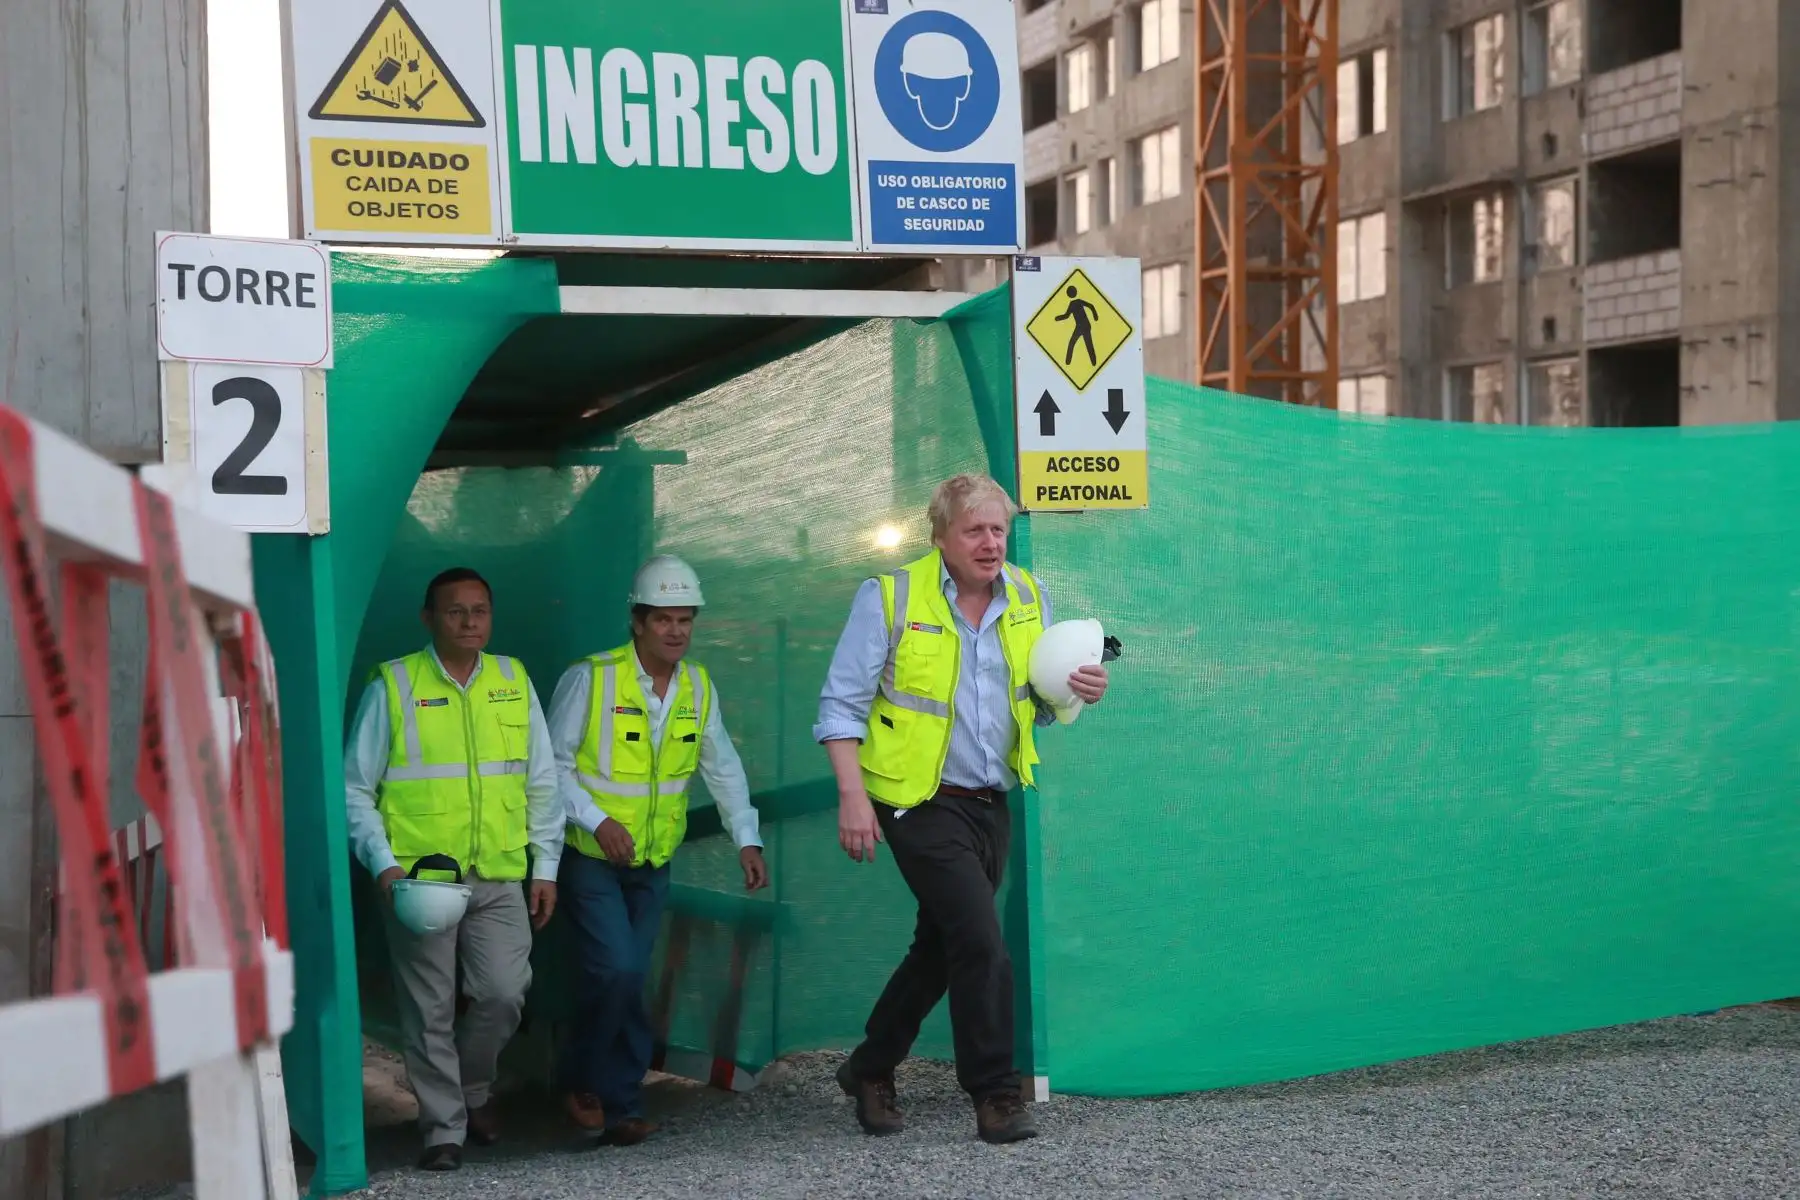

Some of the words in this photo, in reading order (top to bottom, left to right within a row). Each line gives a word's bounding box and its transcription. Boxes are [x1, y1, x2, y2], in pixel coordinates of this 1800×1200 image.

[514, 44, 838, 175] INGRESO
[331, 148, 470, 171] CUIDADO
[346, 176, 421, 193] CAIDA
[428, 179, 458, 195] DE
[878, 175, 907, 187] USO
[911, 175, 1007, 189] OBLIGATORIO
[347, 200, 460, 219] OBJETOS
[897, 197, 915, 209] DE
[920, 197, 967, 210] CASCO
[972, 197, 990, 210] DE
[904, 218, 984, 231] SEGURIDAD
[168, 263, 316, 309] TORRE
[212, 376, 288, 495] 2
[1046, 456, 1120, 473] ACCESO
[1036, 485, 1132, 501] PEATONAL
